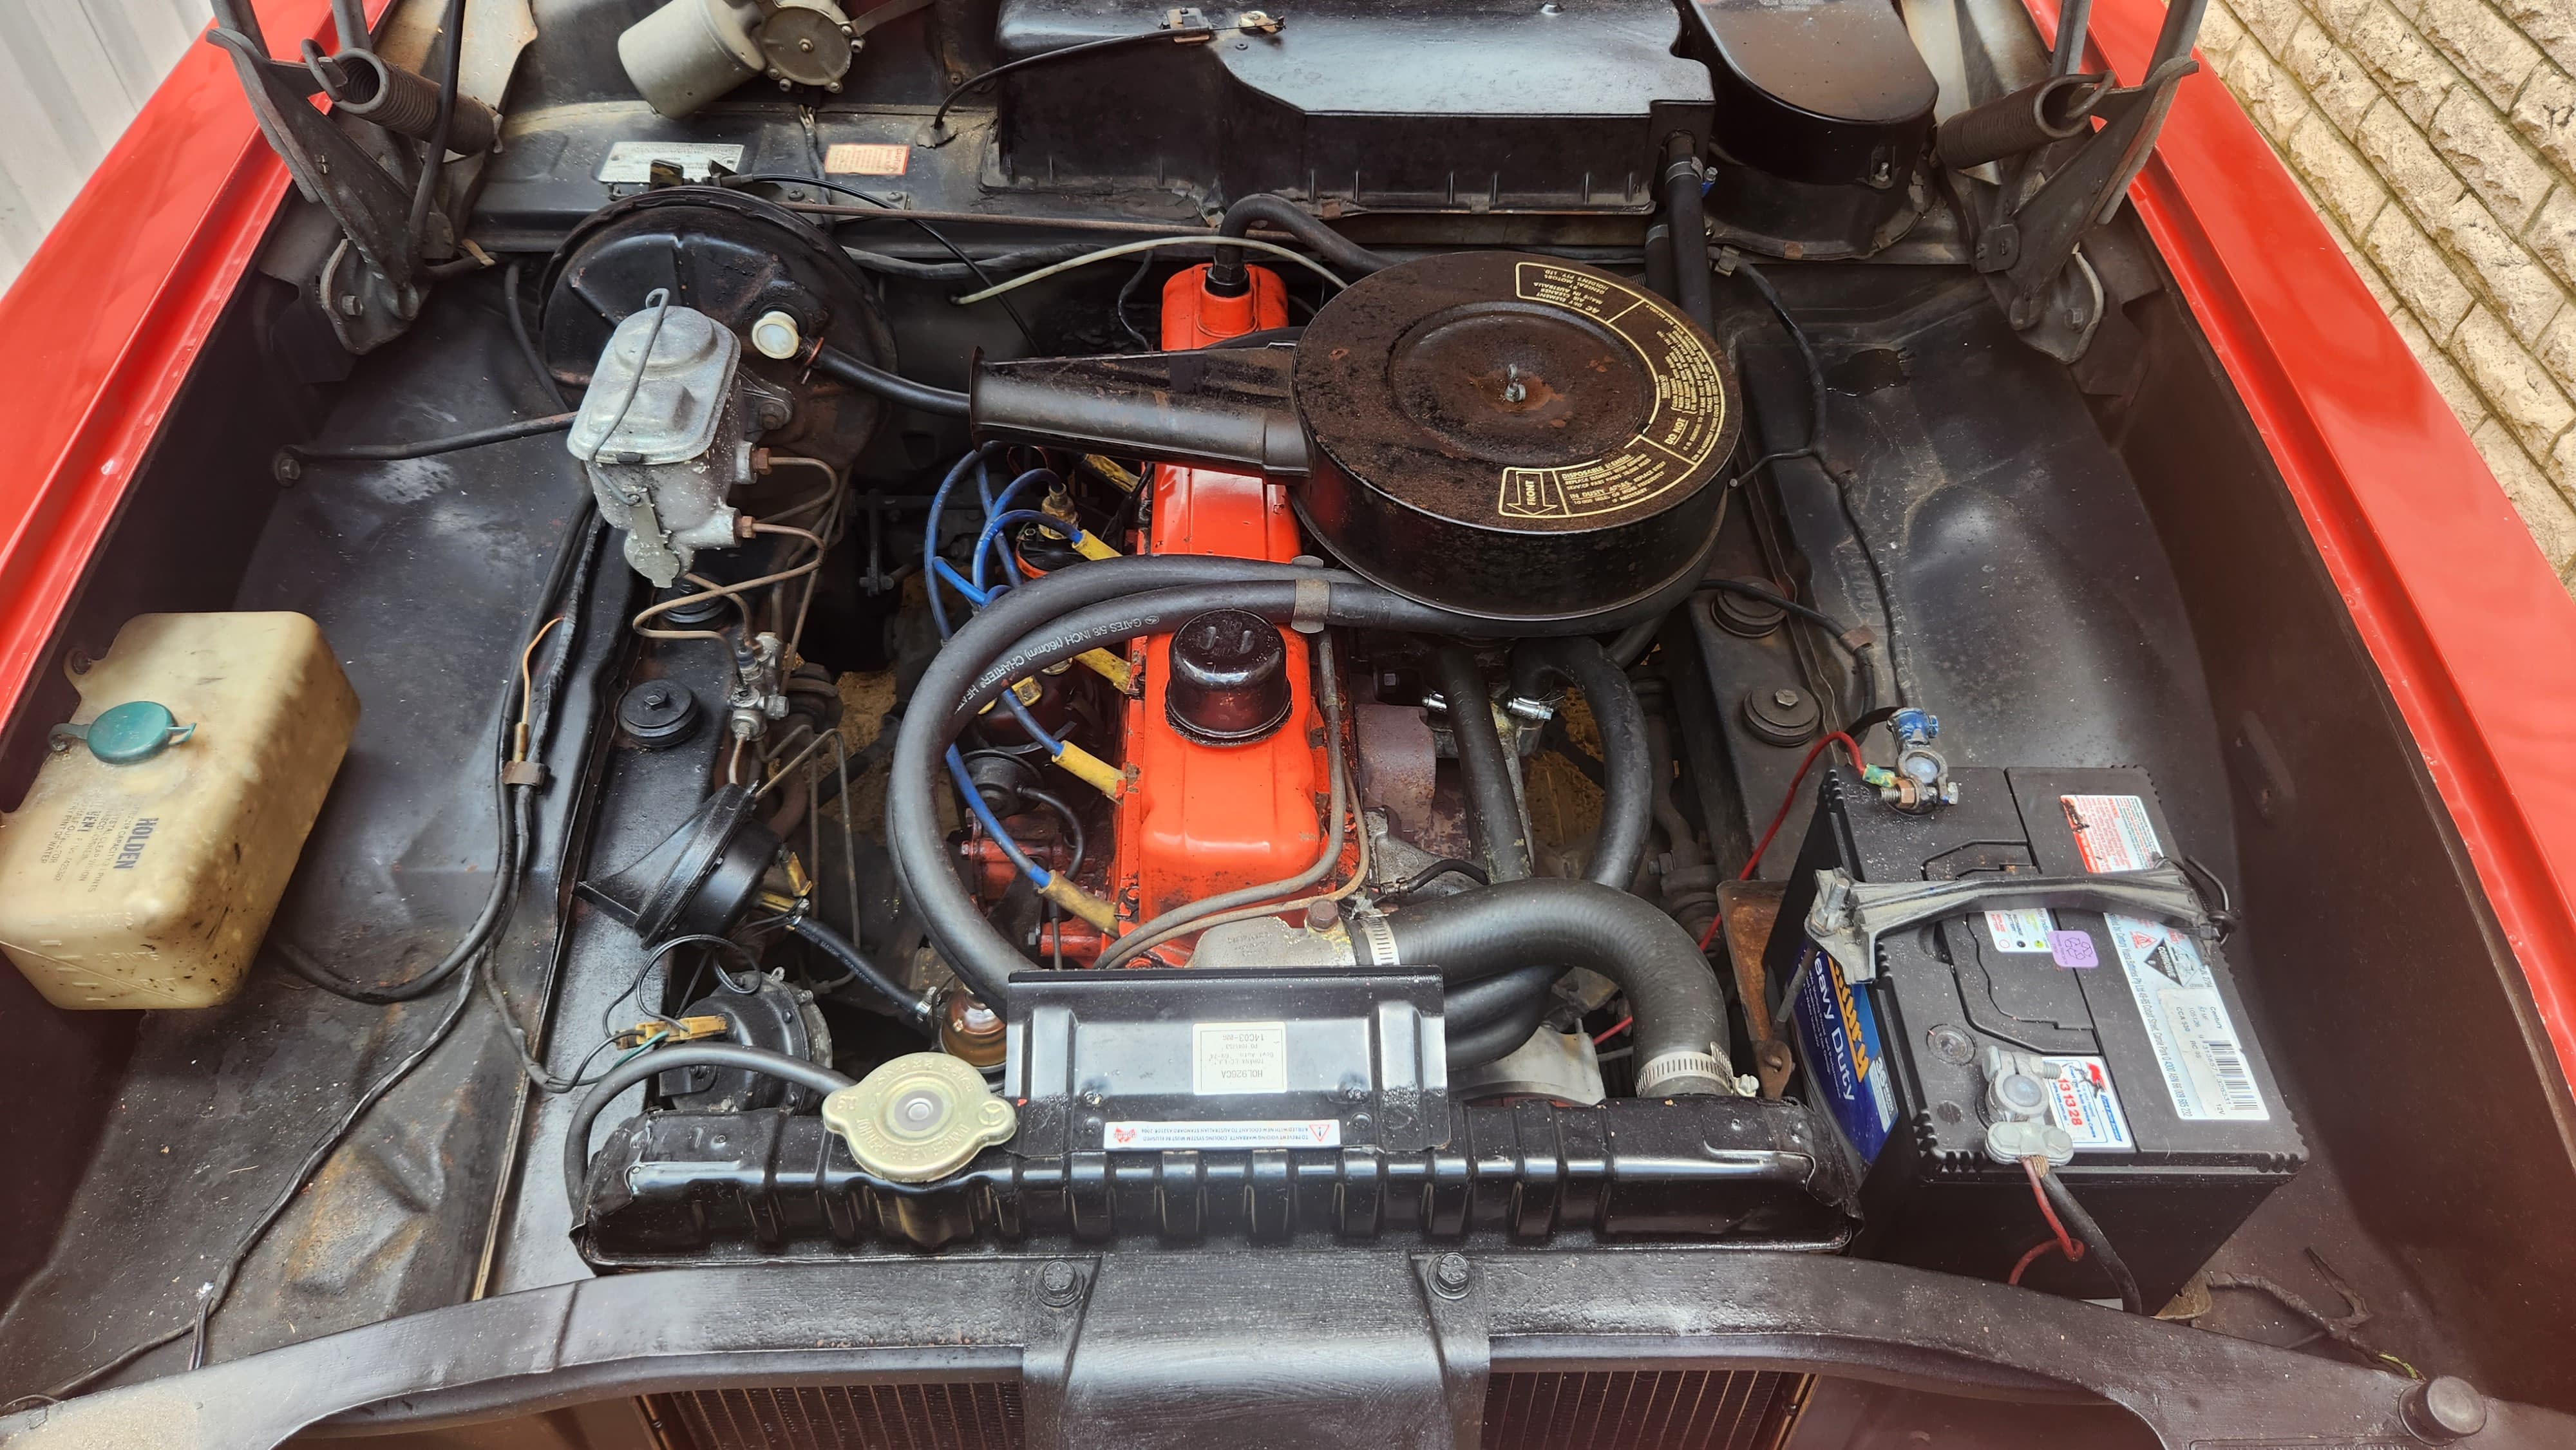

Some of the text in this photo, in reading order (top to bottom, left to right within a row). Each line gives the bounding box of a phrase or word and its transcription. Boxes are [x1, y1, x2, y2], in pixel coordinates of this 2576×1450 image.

[1533, 281, 1571, 294] AUSTRALIA
[1543, 274, 1573, 284] MOTORS
[1535, 291, 1601, 314] AC DRY ELEMENT
[1540, 287, 1571, 298] CLEANER
[1663, 417, 1685, 445] DO NOT
[1560, 453, 1632, 478] DISPOSABLE ELEMENT
[1525, 480, 1537, 505] FRONT
[1580, 488, 1606, 496] DUSTY
[1094, 625, 1108, 637] 5/8
[1110, 618, 1142, 633] GATES
[1065, 629, 1092, 646] INCH
[38, 815, 73, 864] PINT OF WATER
[103, 831, 127, 860] CAPACITY
[112, 818, 159, 869] HOLDEN
[77, 859, 97, 881] VISION
[86, 872, 104, 892] PINTS
[2156, 946, 2177, 977] CORROSIVE
[2141, 1004, 2156, 1017] Cobalt
[2208, 1006, 2224, 1029] Century
[1814, 951, 1855, 1100] eavy Duty
[2152, 1032, 2167, 1046] Carole
[2157, 1046, 2171, 1056] Park
[2175, 1007, 2186, 1019] CCA
[2189, 1040, 2198, 1049] RC
[2215, 1104, 2225, 1115] 12V
[1220, 1069, 1262, 1078] HOL926CA
[1875, 1056, 1888, 1088] 36
[2163, 1060, 2177, 1071] 4300
[2202, 1045, 2231, 1104] 313857 326331
[2167, 1073, 2181, 1082] ABN
[2056, 1078, 2084, 1125] 13 13 28
[2181, 1108, 2193, 1116] 232
